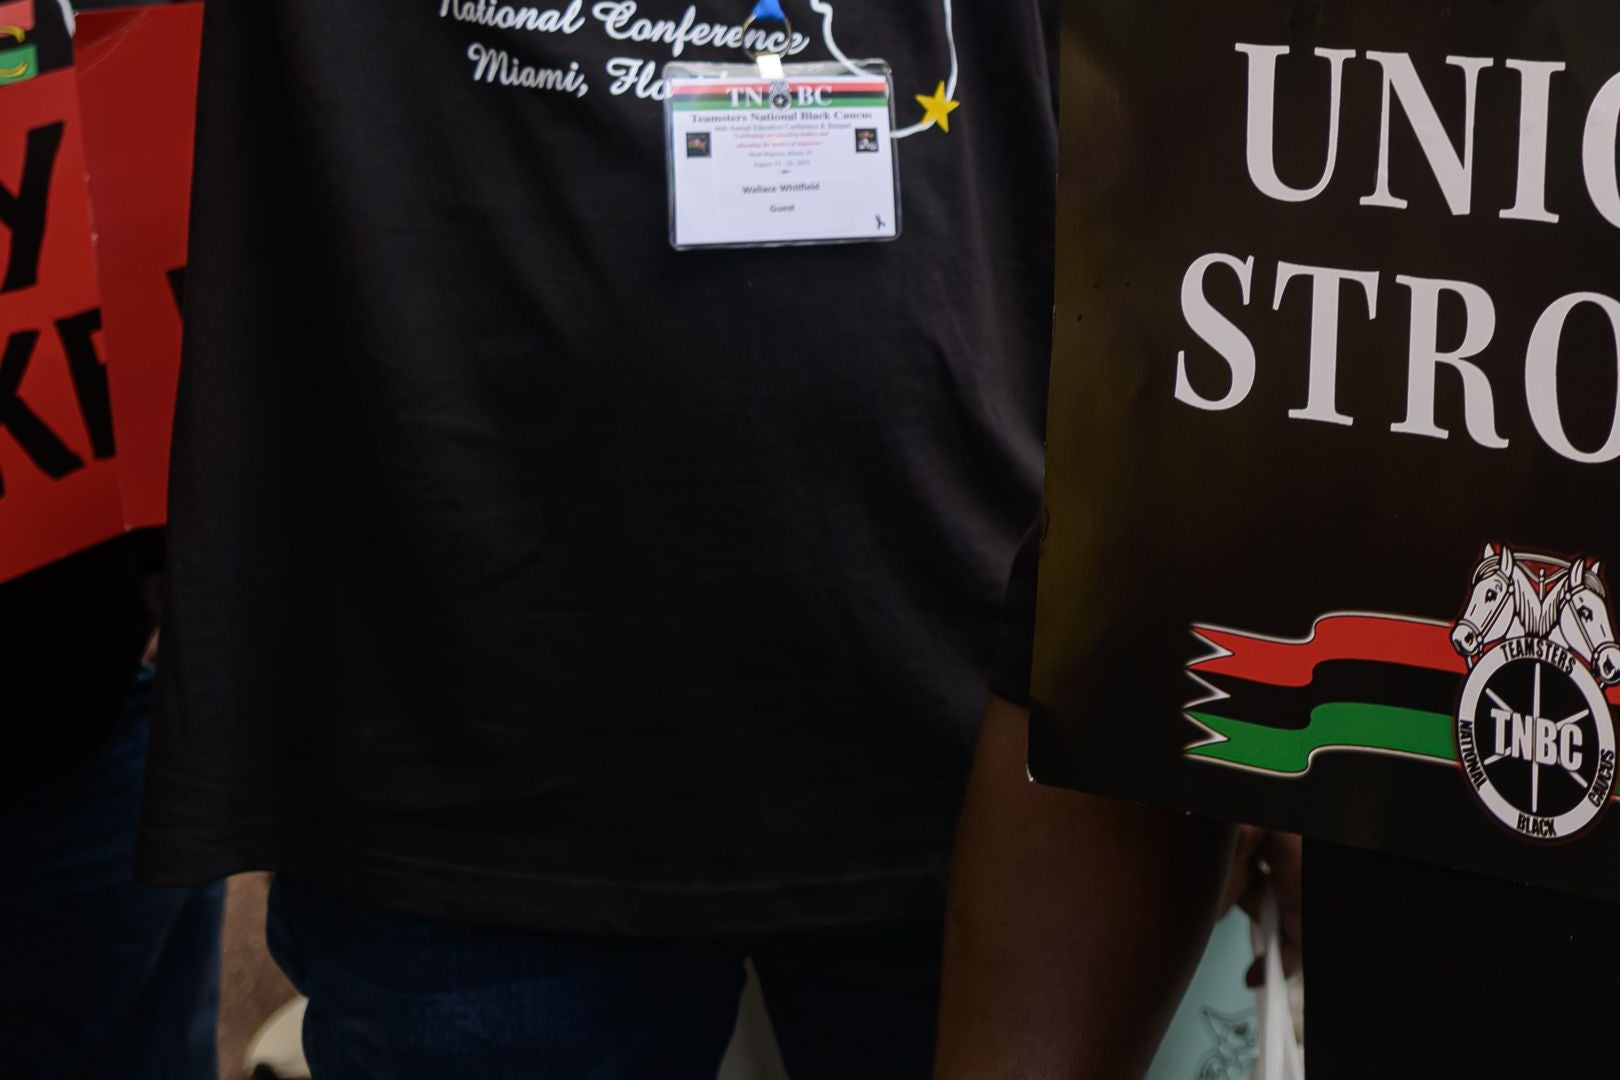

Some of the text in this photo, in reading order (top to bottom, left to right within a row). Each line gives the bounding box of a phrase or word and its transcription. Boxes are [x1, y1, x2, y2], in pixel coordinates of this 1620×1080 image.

[591, 0, 811, 57] Conference
[467, 43, 590, 98] Miami,
[726, 85, 833, 107] TN BC
[751, 112, 798, 122] National
[800, 111, 831, 121] Black
[1500, 638, 1577, 676] TEAMSTERS
[1490, 707, 1584, 771] TNBC
[1458, 720, 1616, 837] NATIONAL BLACK CAUCUS
